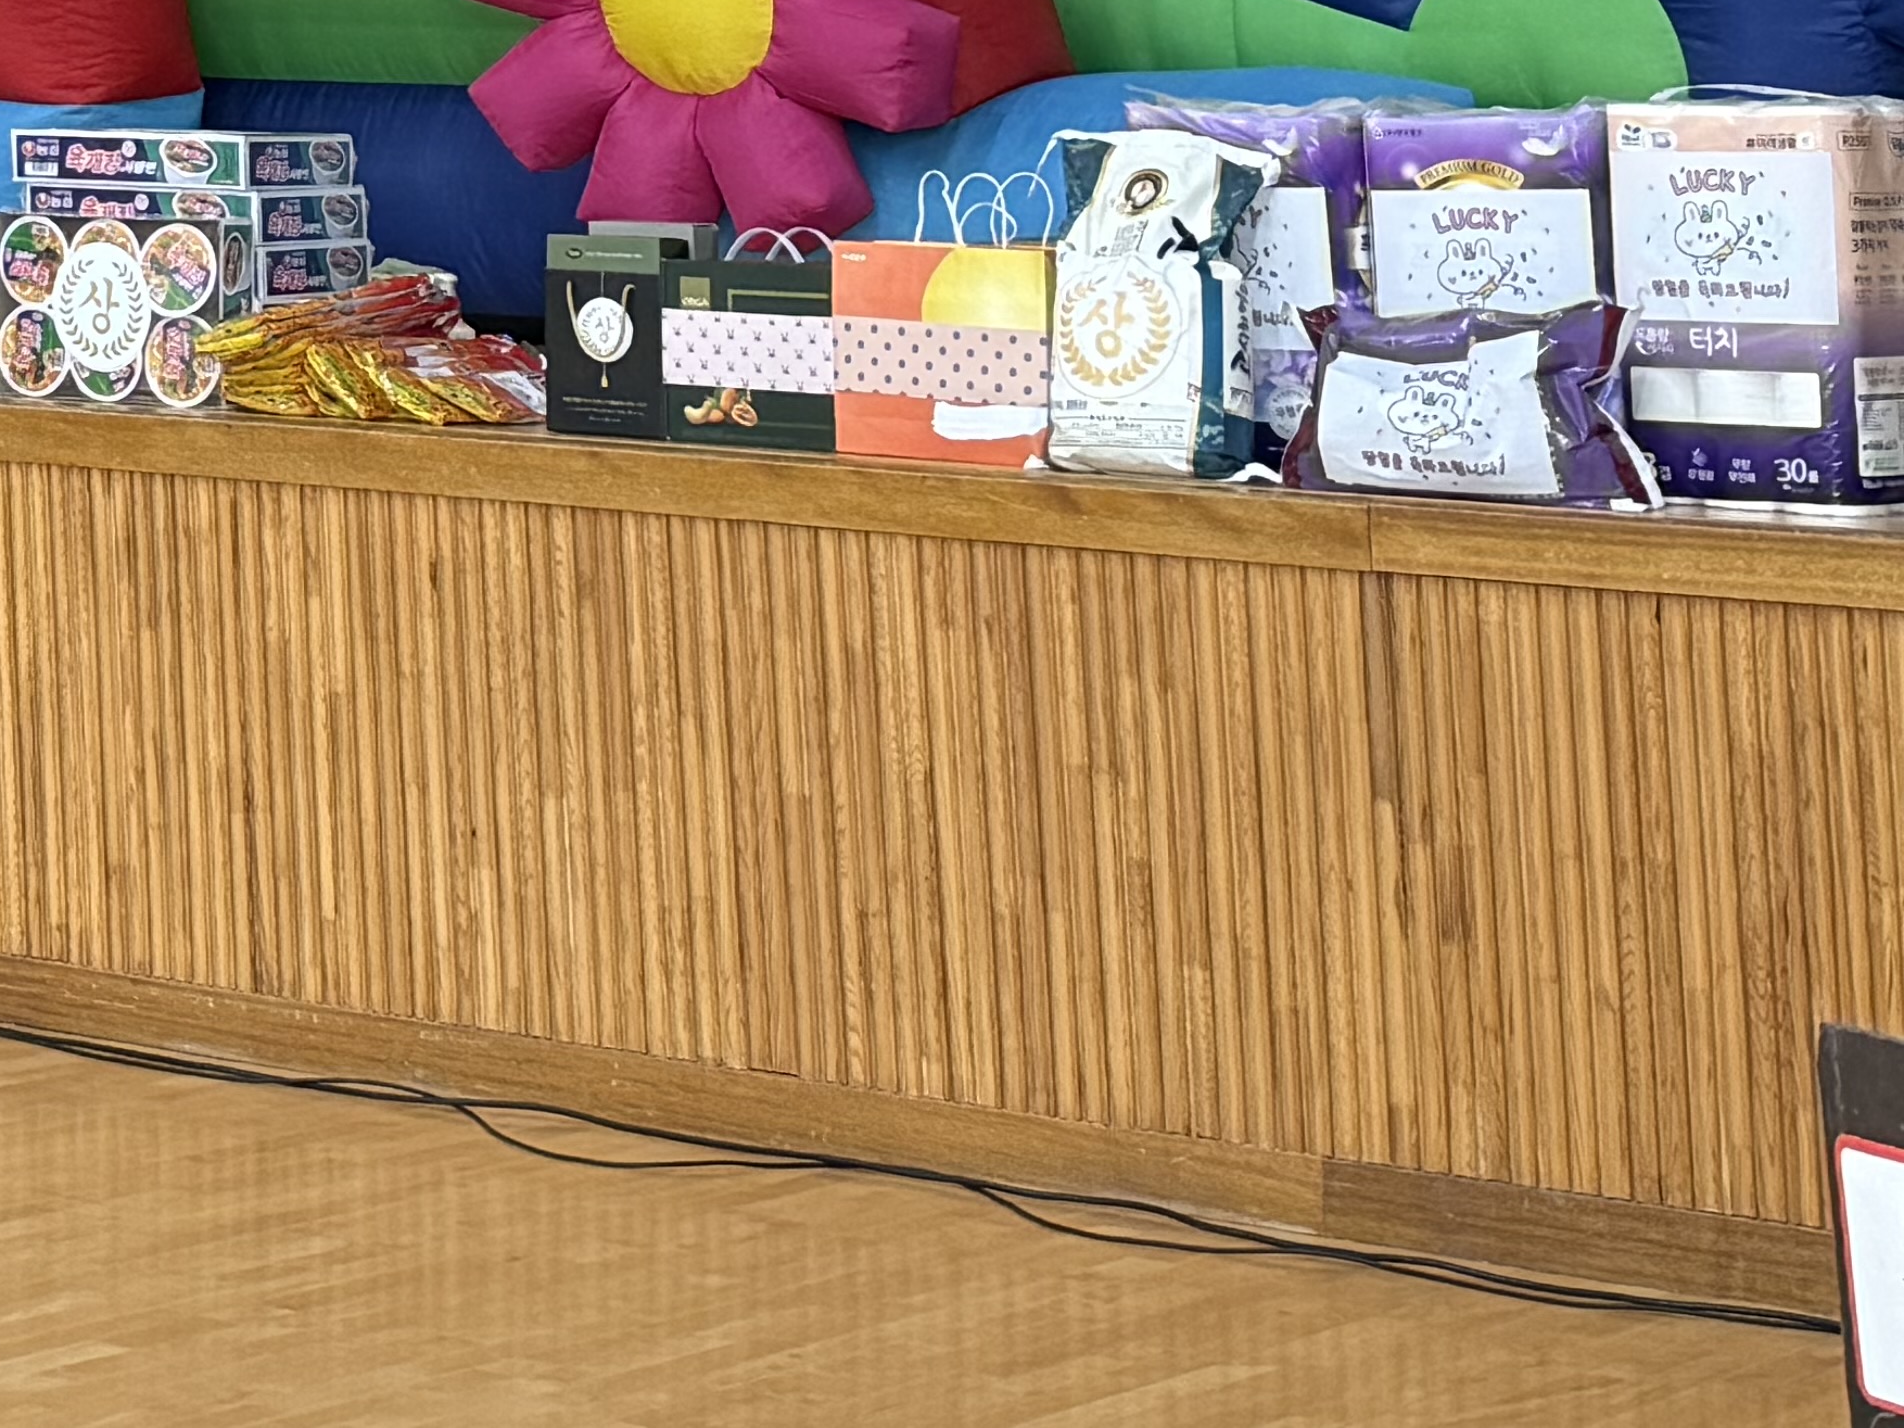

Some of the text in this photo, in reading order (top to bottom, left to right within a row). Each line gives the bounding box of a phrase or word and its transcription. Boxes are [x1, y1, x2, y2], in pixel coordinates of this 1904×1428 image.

[1481, 161, 1521, 185] GOLD
[1668, 167, 1756, 196] LUCKY
[1431, 207, 1520, 235] LUCKY
[79, 276, 121, 335] 상
[1076, 290, 1136, 359] 상
[1688, 325, 1739, 358] 터치
